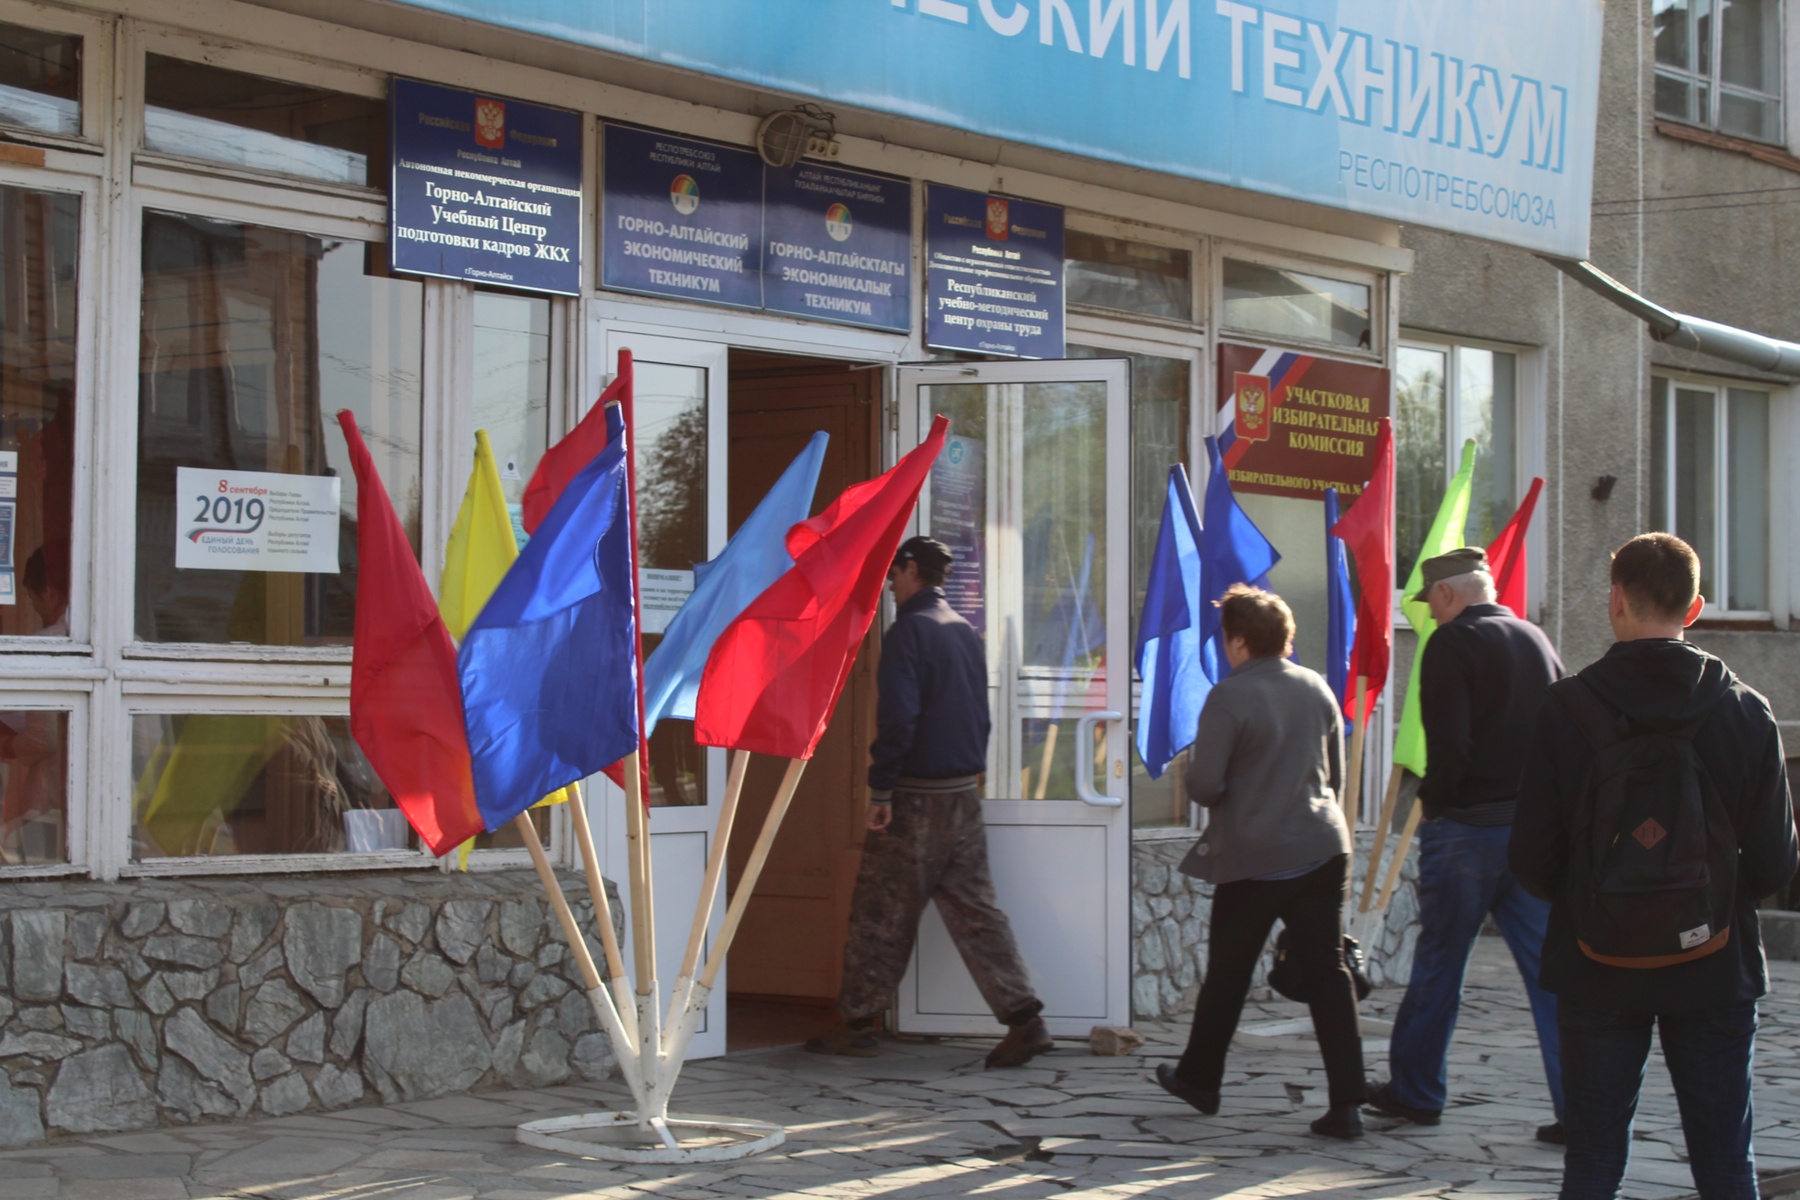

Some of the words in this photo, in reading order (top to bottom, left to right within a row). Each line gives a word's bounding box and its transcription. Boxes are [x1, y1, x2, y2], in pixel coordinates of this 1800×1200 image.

[1216, 0, 1568, 174] ТЕХНИКУМ
[649, 152, 695, 168] РЕСПУБЛИКИ
[696, 162, 721, 173] АЛТАЙ
[655, 142, 716, 161] РЕСПОТРЕБСОЮЗ
[399, 158, 453, 176] Автономная
[455, 168, 526, 188] некоммерческая
[527, 180, 581, 198] организация
[1338, 150, 1557, 229] РЕСПОТРЕБСОЮЗА
[425, 181, 552, 217] Горно-Алтайский
[431, 205, 499, 230] Учебный
[502, 217, 547, 242] Центр
[618, 215, 749, 250] ГОРНО-АЛТАЙСКИЙ
[397, 226, 479, 249] подготовки
[482, 238, 531, 258] кадров
[533, 243, 570, 263] ЖКХ
[624, 240, 743, 273] ЭКОНОМИЧЕСКИЙ
[770, 241, 905, 276] ГОРНО-АЛТАЙСКТАГЫ
[648, 268, 720, 293] ТЕХНИКУМ
[782, 266, 892, 297] ЭКОНОМИКАЛЫК
[947, 279, 1037, 303] Республиканский
[805, 293, 872, 316] ТЕХНИКУМ
[939, 296, 1049, 321] учебно-методический
[944, 313, 974, 330] центр
[976, 317, 1012, 332] охраны
[1014, 323, 1042, 337] труда
[1285, 386, 1370, 413] УЧАСТКОВАЯ
[1272, 406, 1380, 437] ИЗБИРАТЕЛЬНАЯ
[1289, 432, 1365, 457] КОМИССИЯ
[218, 479, 228, 493] 8
[230, 486, 268, 496] сентября
[1228, 469, 1310, 490] ИЗБИРАТЕЛЬНОГО
[193, 495, 265, 526] 2019
[201, 535, 234, 545] ЕДИНЫЙ
[235, 537, 254, 545] ДЕНЬ
[208, 545, 260, 555] ГОЛОСОВАНИЯ
